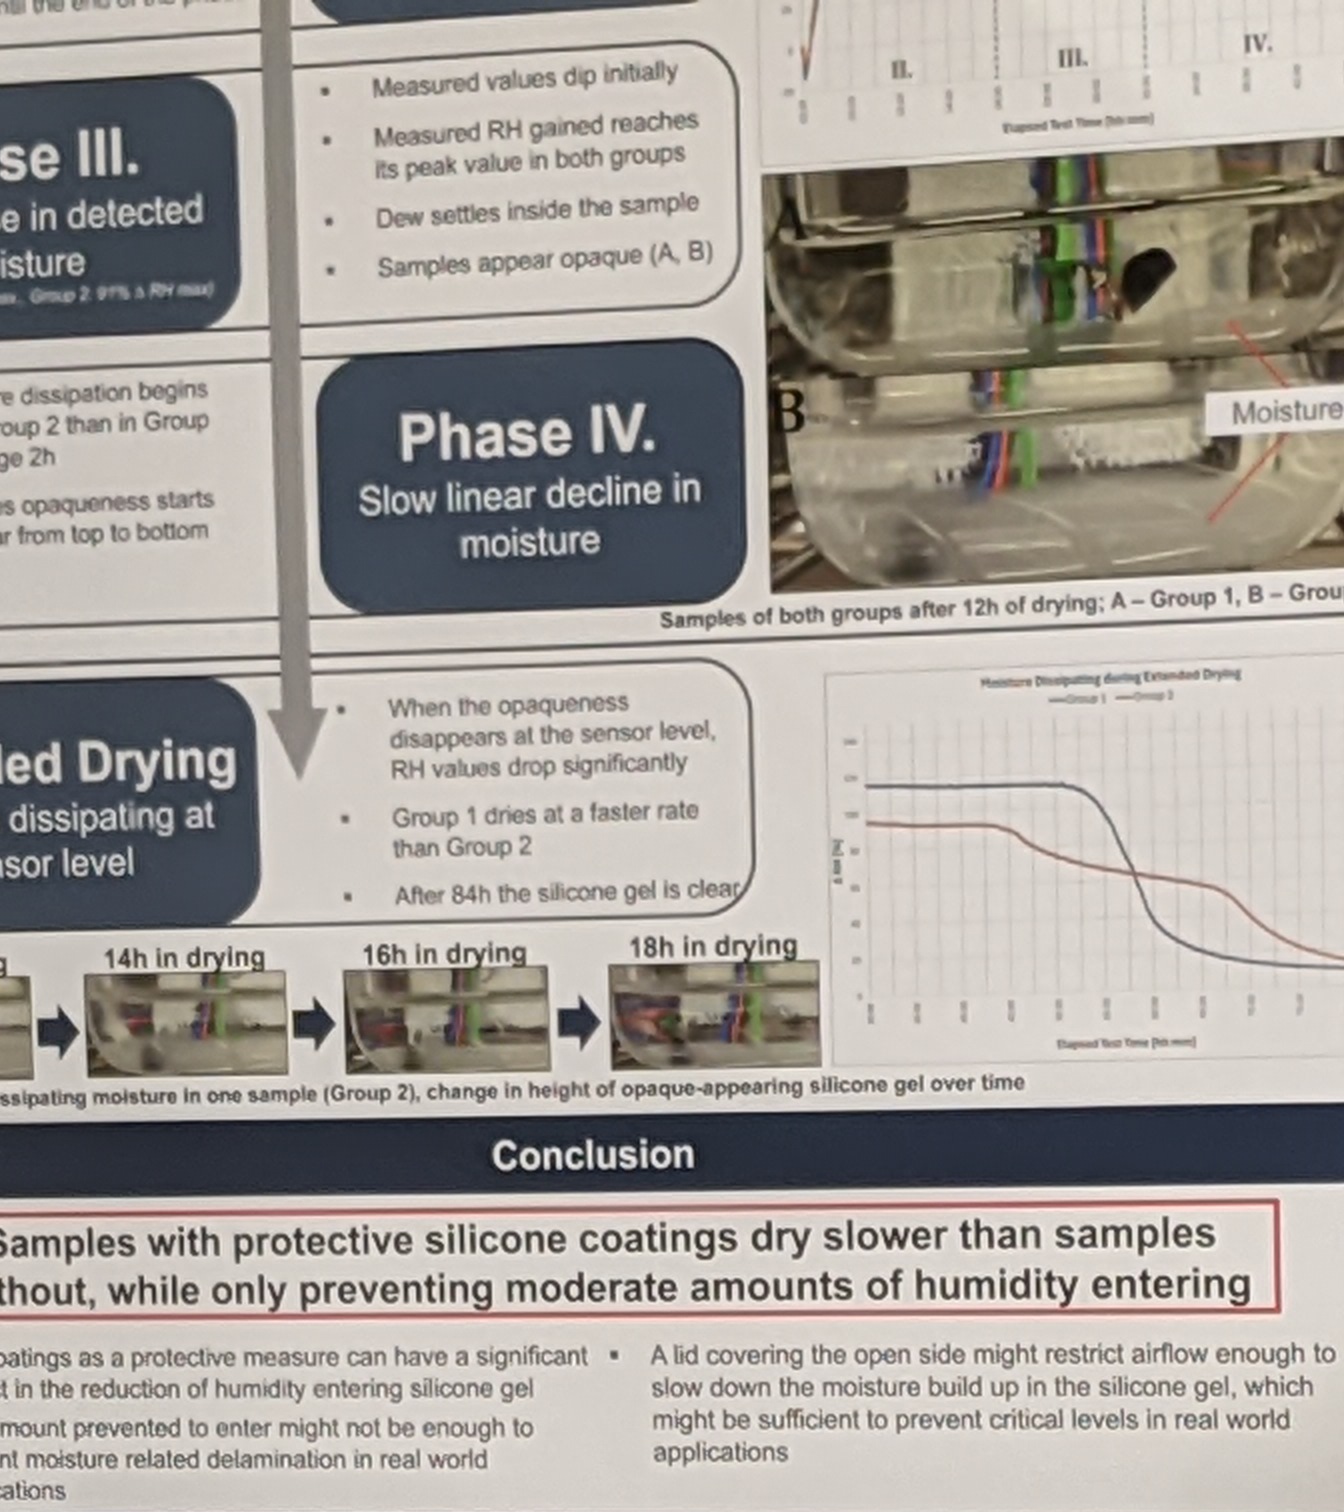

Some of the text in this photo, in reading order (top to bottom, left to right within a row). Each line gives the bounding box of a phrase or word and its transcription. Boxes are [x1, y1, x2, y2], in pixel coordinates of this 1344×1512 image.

[1058, 47, 1088, 69] III.
[1244, 33, 1273, 54] IV.
[371, 58, 679, 100] Measured values dip initially
[891, 59, 913, 80] II.
[373, 109, 700, 149] Measured RH gained reaches
[79, 125, 139, 178] III.
[31, 200, 57, 233] in
[67, 191, 204, 231] detected
[377, 238, 714, 282] Samples appear opaque (A, B)
[20, 382, 132, 410] dissipation
[138, 379, 209, 409] begins
[775, 388, 805, 433] B
[1232, 398, 1344, 426] Moisture
[400, 401, 655, 463] Phase IV.
[359, 471, 701, 518] Slow linear decline in
[460, 525, 601, 560] moisture
[659, 593, 1104, 633] Samples of both groups after 12h of drying;
[79, 736, 237, 794] Drying
[390, 750, 689, 782] RH values drop significantly
[9, 799, 174, 839] dissipating
[185, 799, 216, 830] at
[63, 844, 135, 879] level
[394, 878, 742, 907] After 84h the silicone gel is clear
[630, 932, 798, 963] 18h in drying
[492, 1136, 695, 1172] Conclusion
[148, 1225, 220, 1258] with
[234, 1223, 413, 1266] protective
[426, 1222, 566, 1256] silicone
[579, 1220, 737, 1261] coatings
[751, 1219, 811, 1261] dry
[824, 1218, 948, 1252] slower
[959, 1216, 1041, 1251] than
[1055, 1215, 1216, 1258] samples
[108, 1272, 199, 1307] while
[212, 1272, 286, 1315] only
[300, 1271, 493, 1314] preventing
[507, 1272, 677, 1302] moderate
[691, 1270, 853, 1302] amounts
[867, 1267, 903, 1300] of
[915, 1266, 1078, 1312] humidity
[1092, 1266, 1251, 1311] entering
[79, 1349, 104, 1369] as
[111, 1349, 124, 1369] a
[131, 1346, 236, 1373] protective
[243, 1349, 340, 1368] measure
[347, 1349, 387, 1368] can
[394, 1344, 448, 1368] have
[455, 1348, 469, 1368] a
[476, 1343, 589, 1373] significant
